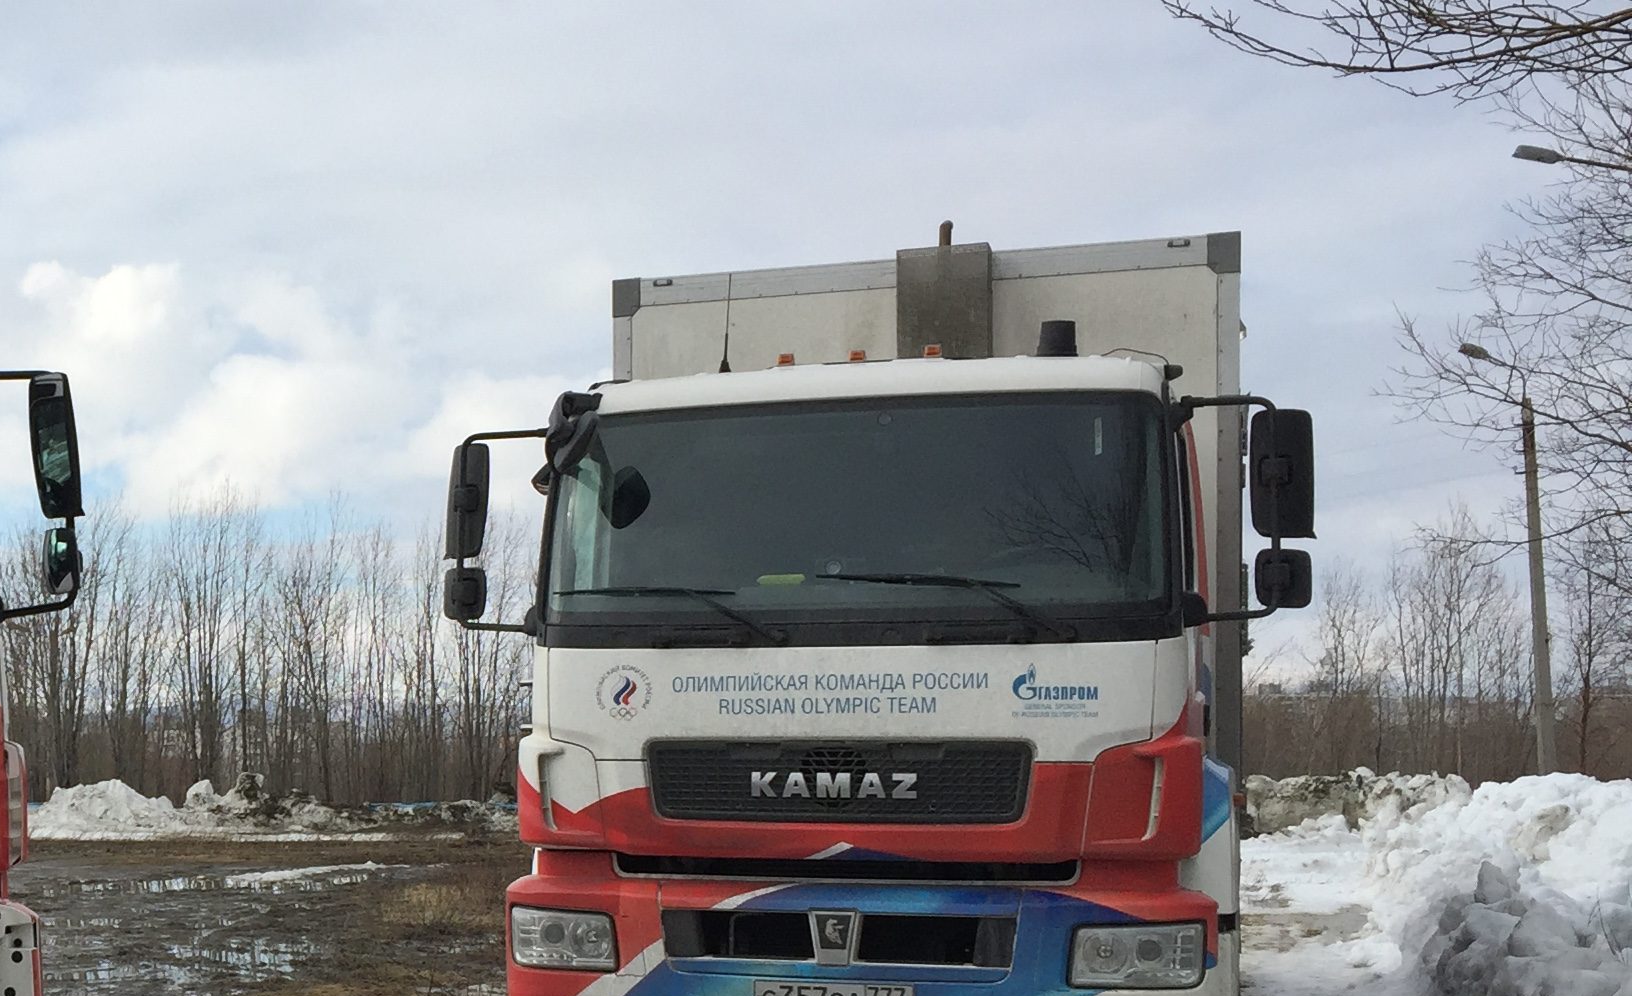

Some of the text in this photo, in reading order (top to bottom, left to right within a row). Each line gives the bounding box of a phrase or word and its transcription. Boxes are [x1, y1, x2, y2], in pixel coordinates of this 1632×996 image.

[672, 672, 989, 693] ОЛИМПИЙСКАЯ КОМАНДА РОССИИ
[1037, 686, 1099, 701] ГАЗПРОМ
[719, 696, 937, 715] RUSSIAN OLYMPIC TEAM
[751, 771, 918, 798] KAMAZ
